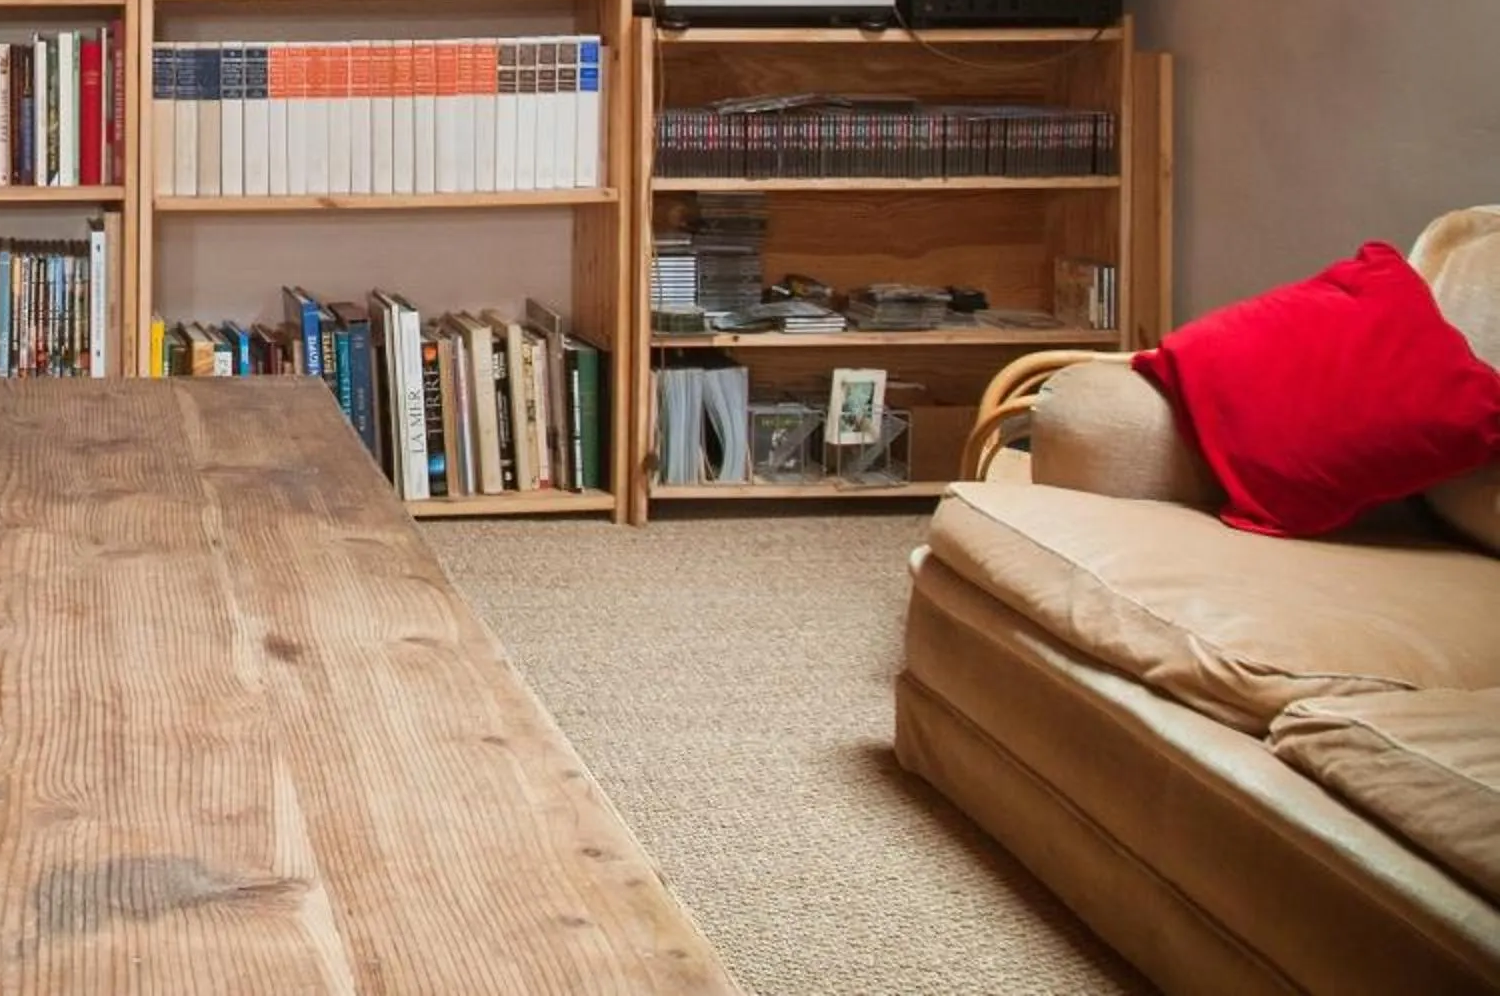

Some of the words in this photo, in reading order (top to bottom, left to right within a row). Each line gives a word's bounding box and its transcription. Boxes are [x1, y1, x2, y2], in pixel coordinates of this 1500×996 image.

[408, 388, 423, 427] MER
[423, 367, 443, 435] TERRE
[411, 433, 425, 453] LA
